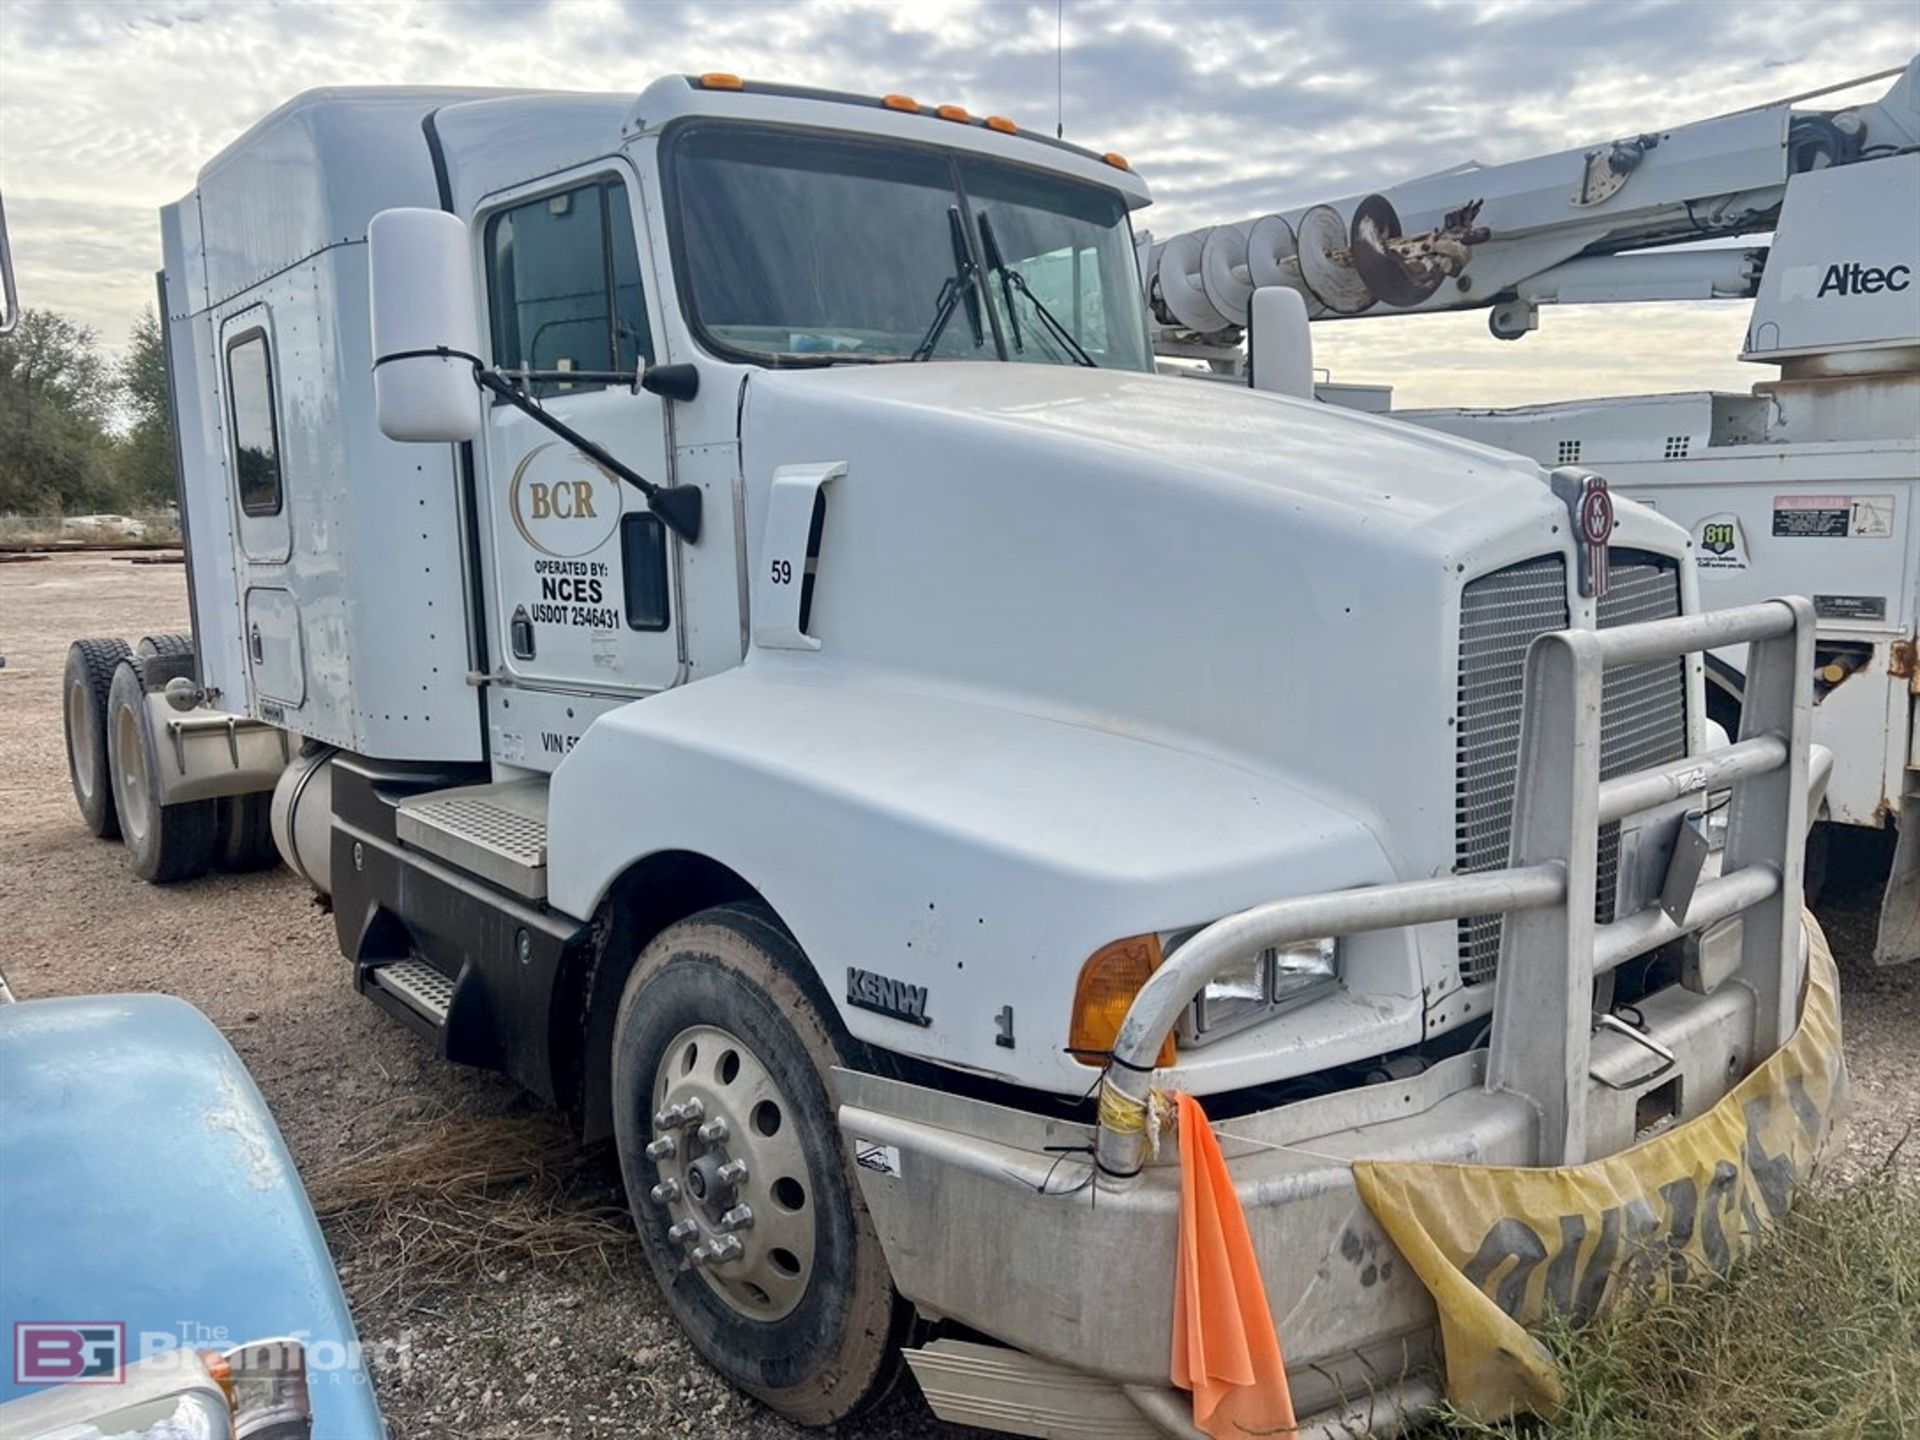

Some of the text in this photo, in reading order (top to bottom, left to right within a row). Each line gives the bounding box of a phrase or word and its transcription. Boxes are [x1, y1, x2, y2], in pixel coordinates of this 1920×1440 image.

[1817, 263, 1910, 298] Altec
[530, 481, 597, 519] BCR
[1705, 525, 1733, 543] 811
[534, 560, 608, 577] OPERATED BY:
[771, 560, 792, 585] 59
[542, 577, 603, 604] NCES
[532, 603, 620, 629] USDOT 2546431
[541, 731, 564, 754] VIN
[847, 966, 930, 1025] KENW
